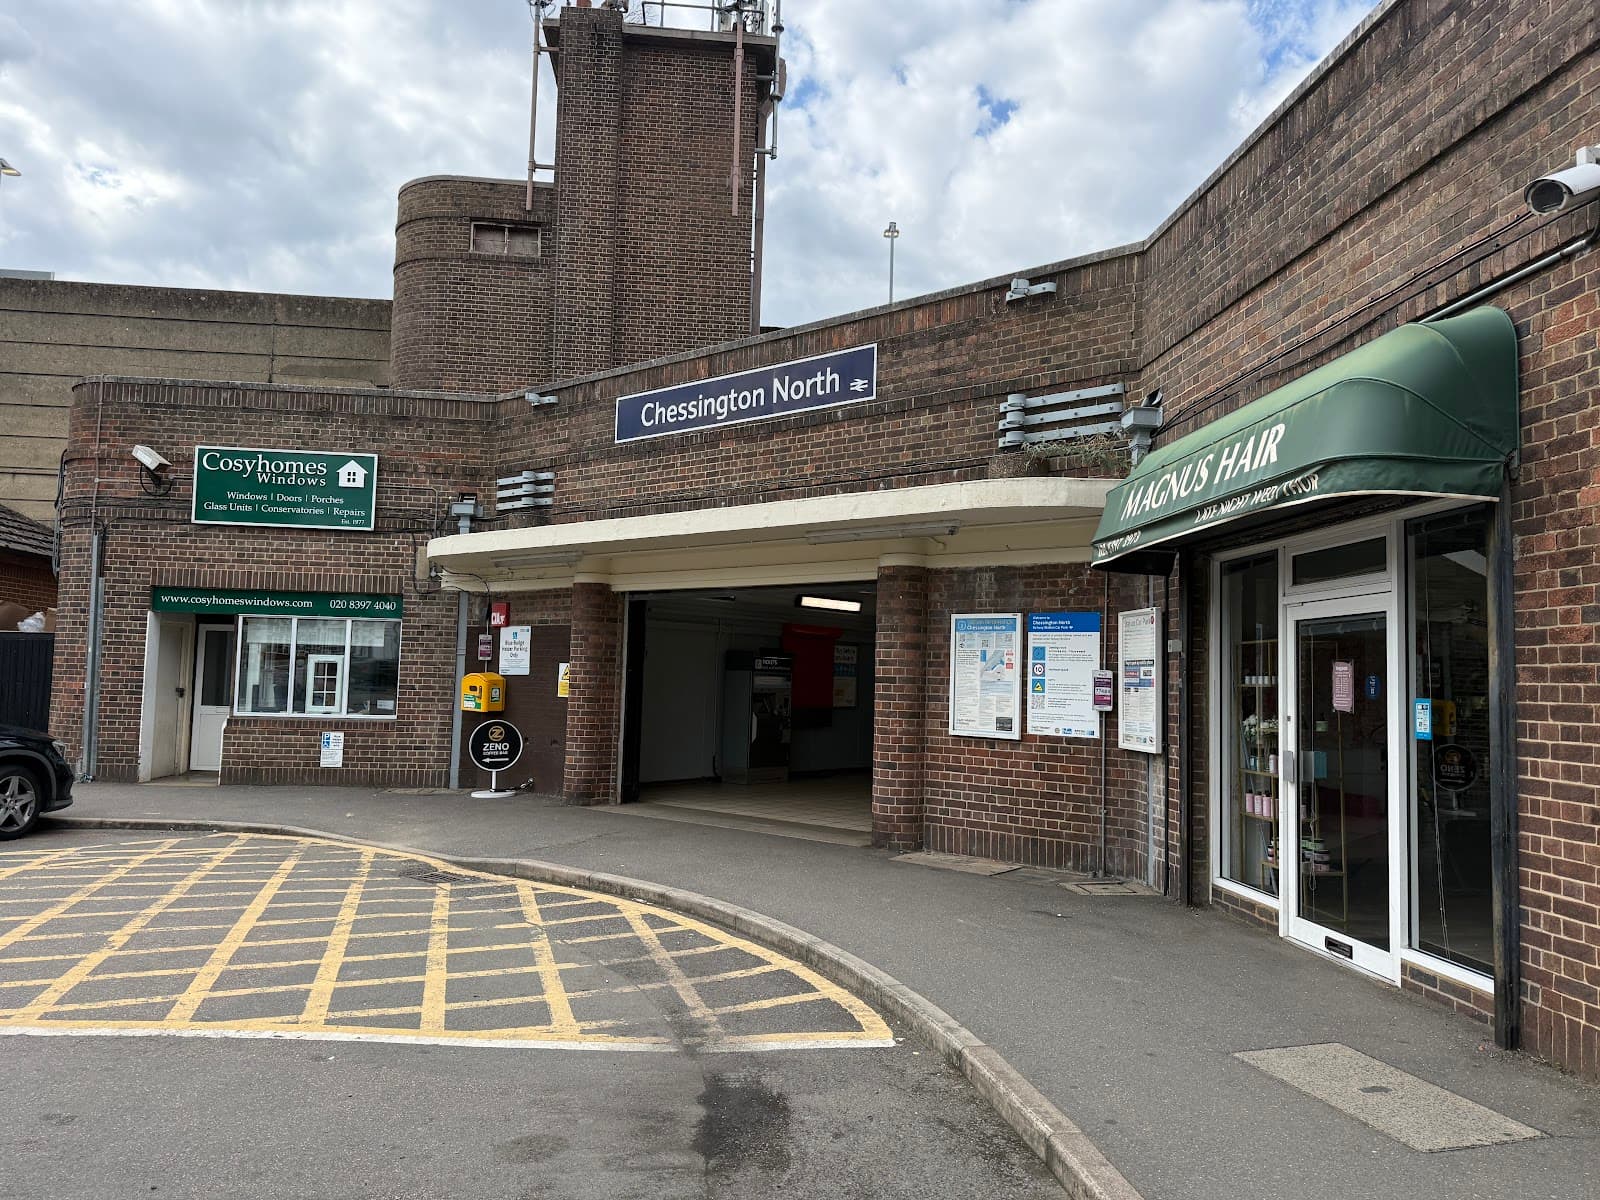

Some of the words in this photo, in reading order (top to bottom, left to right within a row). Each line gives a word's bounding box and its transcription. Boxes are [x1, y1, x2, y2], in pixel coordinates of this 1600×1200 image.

[641, 385, 765, 427] Chessington
[772, 367, 840, 404] North
[202, 452, 327, 478] Cosyhomes
[1120, 453, 1214, 521] MAGNUS
[1214, 423, 1286, 485] HAIR
[257, 472, 326, 486] Windows
[226, 491, 268, 501] Windows
[276, 493, 302, 502] Doors
[311, 495, 344, 504] Porches
[203, 502, 228, 511] Glass
[229, 503, 252, 512] Units
[261, 504, 324, 515] Conservatories
[333, 507, 366, 517] Repairs
[1194, 504, 1219, 524] LATE
[1218, 493, 1251, 517] NIGHT
[161, 594, 313, 608] www.cosyhomeswindows.com
[329, 599, 347, 609] 020
[349, 600, 371, 610] 8397
[373, 601, 396, 611] 4040
[482, 742, 509, 751] ZENO
